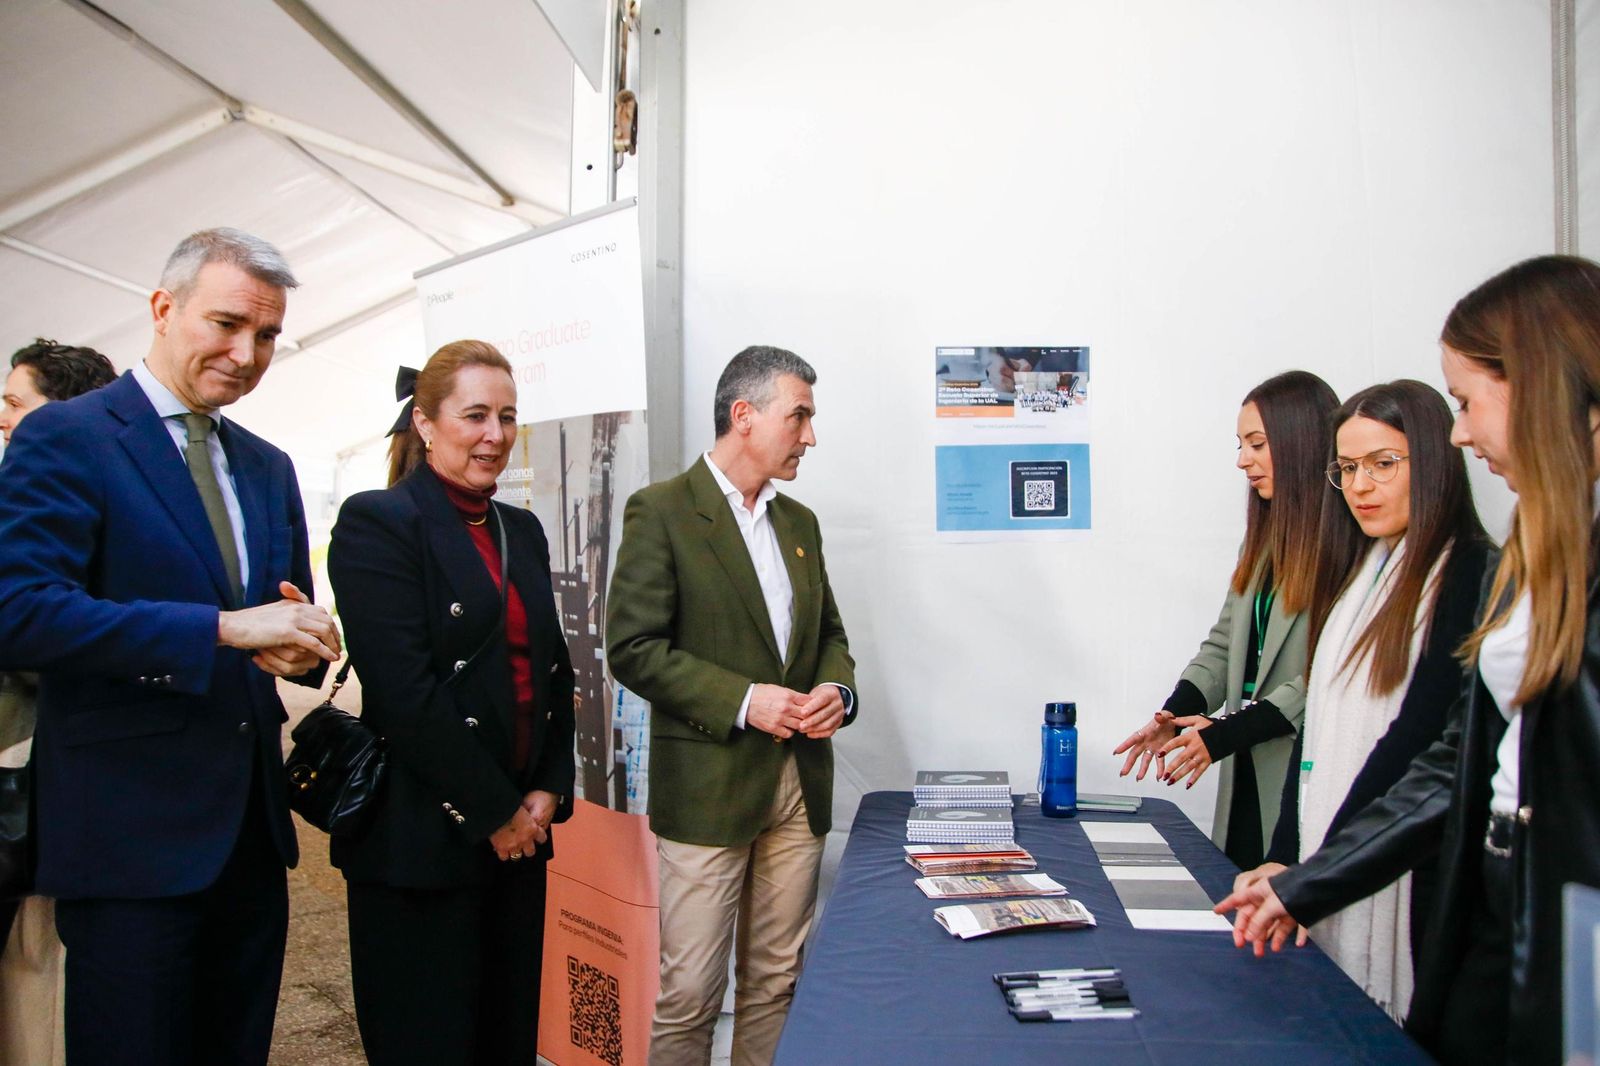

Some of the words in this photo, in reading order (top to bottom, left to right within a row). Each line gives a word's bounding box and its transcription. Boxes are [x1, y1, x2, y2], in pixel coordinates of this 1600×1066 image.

[570, 242, 617, 264] COSENTINO
[518, 318, 592, 354] Graduate
[558, 920, 573, 933] Para
[560, 908, 596, 931] PROGRAMA
